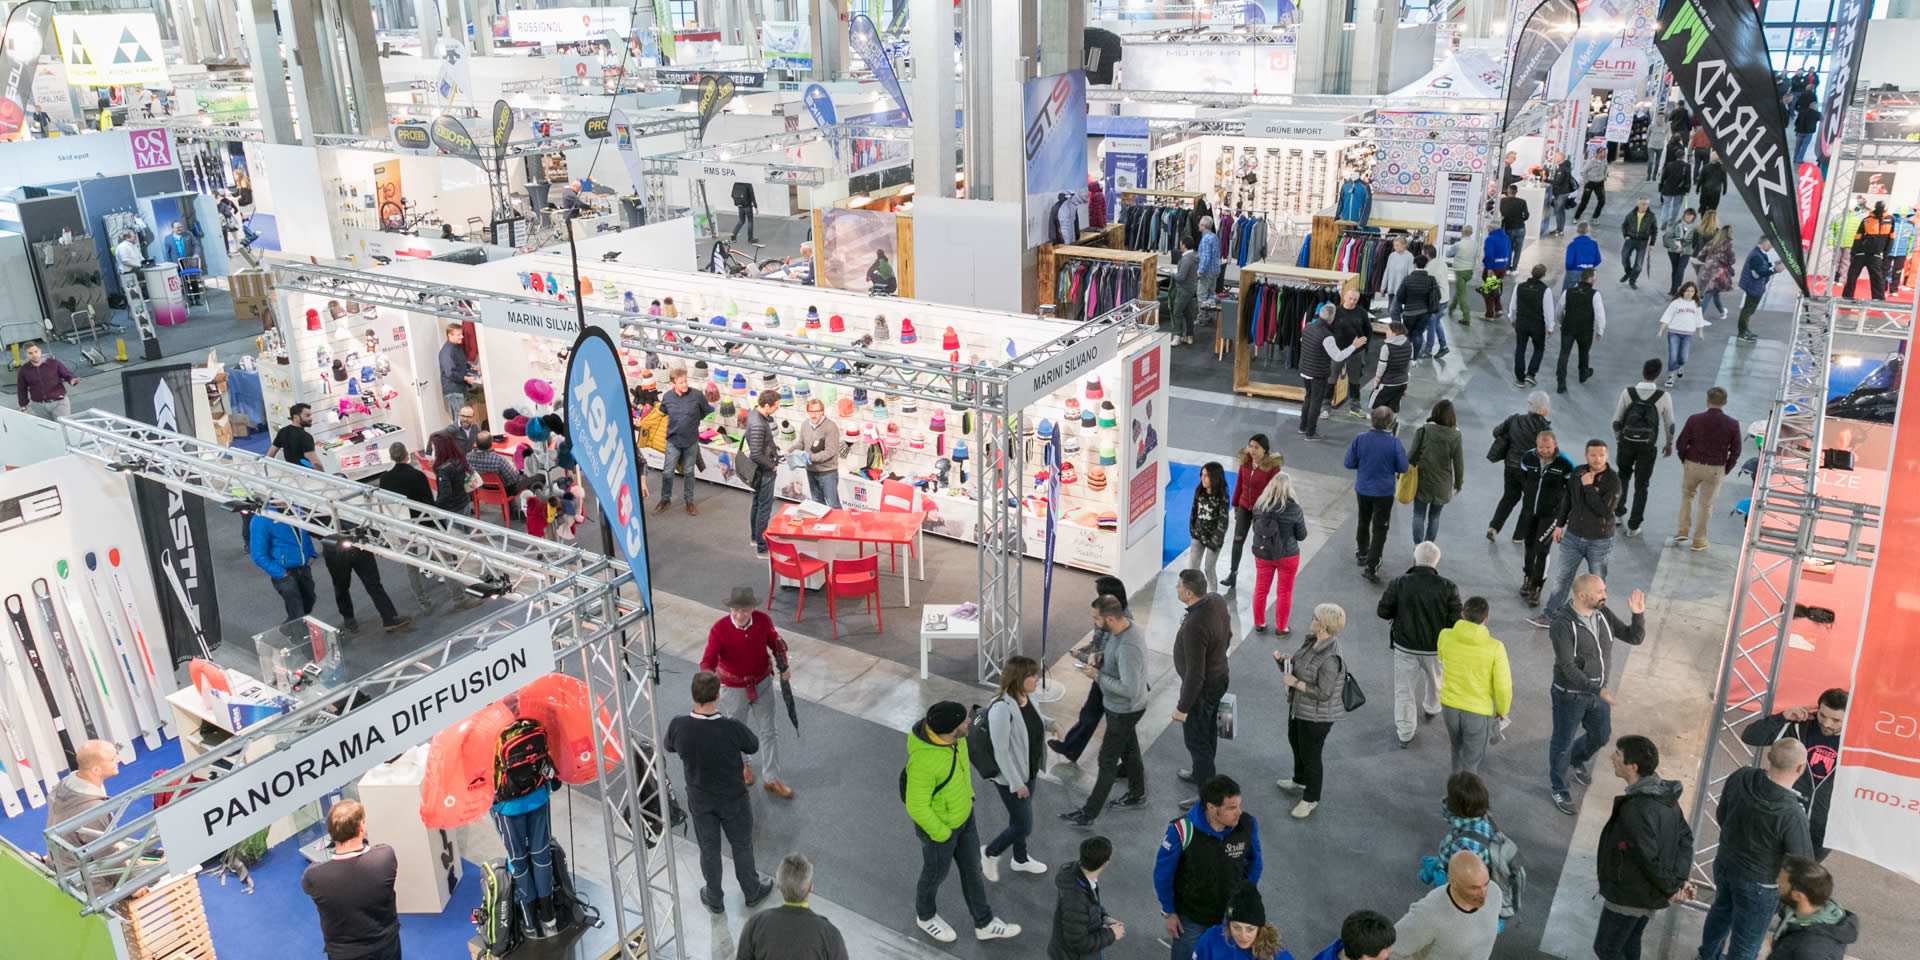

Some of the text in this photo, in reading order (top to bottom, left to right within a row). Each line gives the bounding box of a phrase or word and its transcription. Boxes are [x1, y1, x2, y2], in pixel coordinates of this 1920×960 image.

[517, 22, 563, 33] ROSSIGNOL
[726, 74, 755, 84] WEDEN
[1293, 127, 1323, 136] IMPORT
[704, 167, 736, 177] RMS SPA
[507, 311, 543, 329] MARINI
[1034, 345, 1098, 392] MARINI SILVANO
[203, 648, 527, 836] PANORAMA DIFFUSION
